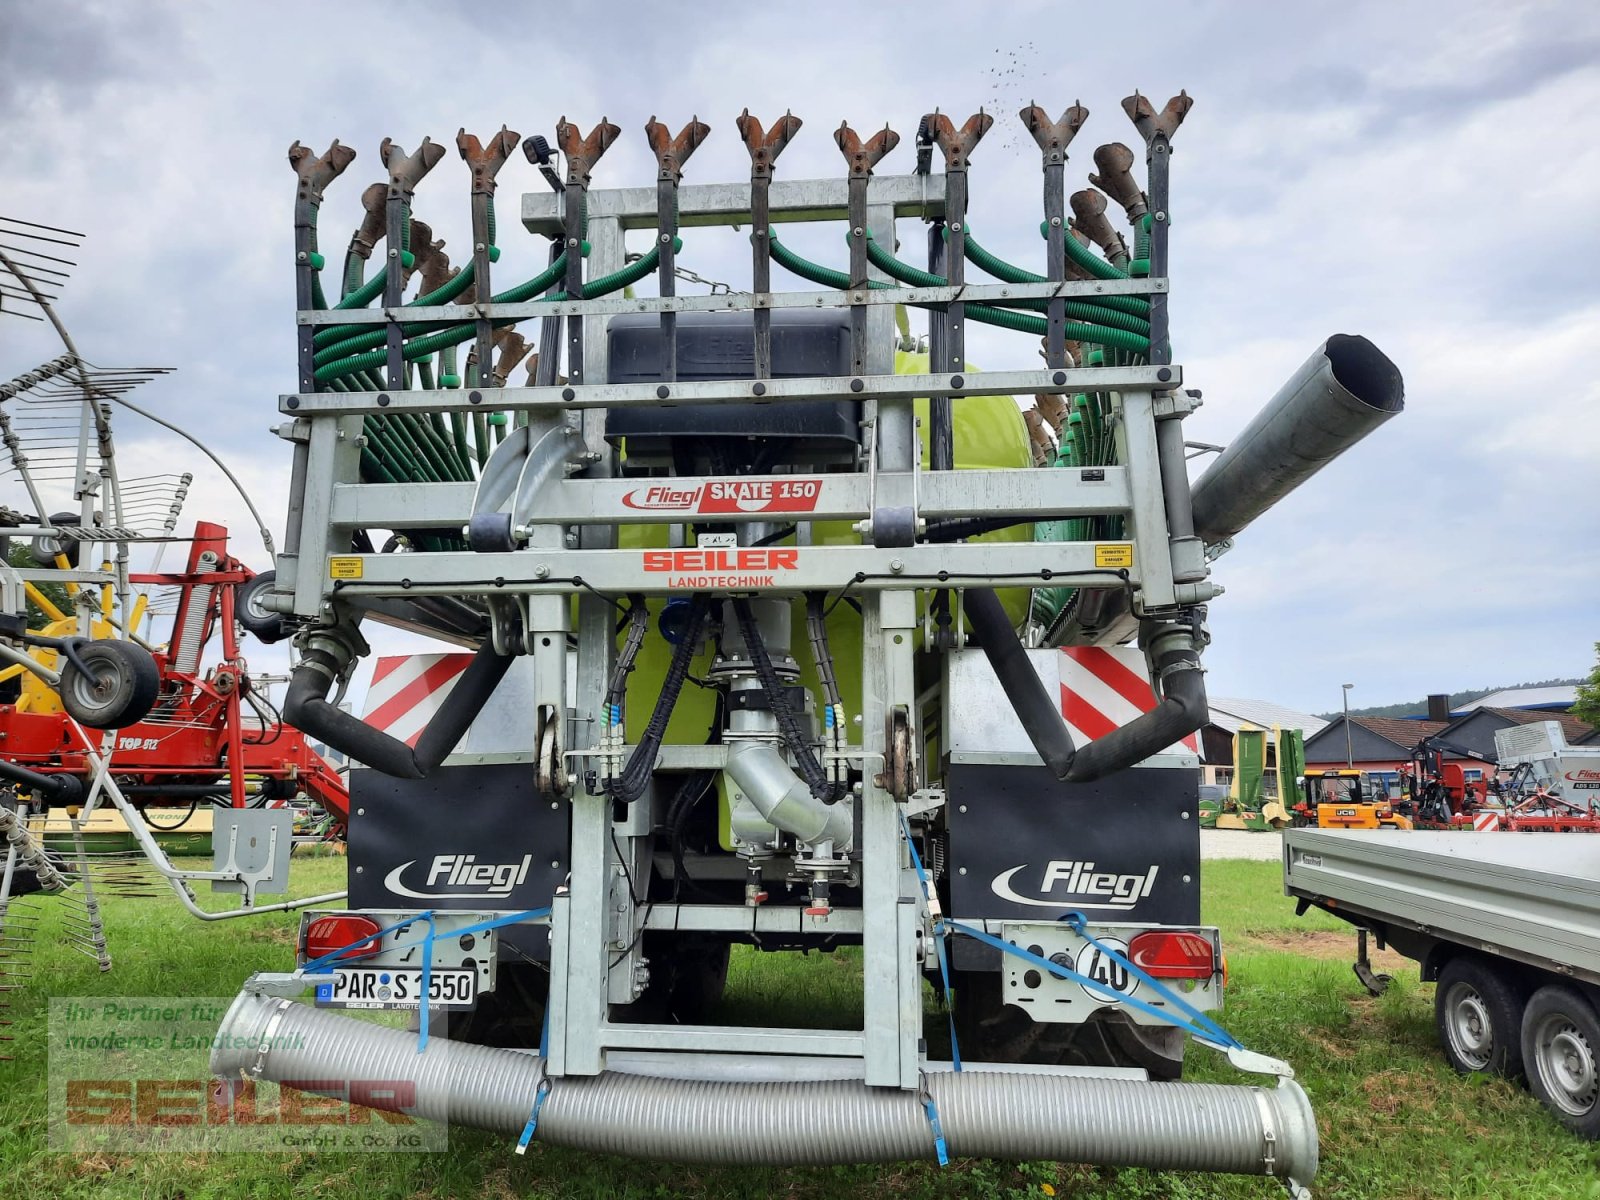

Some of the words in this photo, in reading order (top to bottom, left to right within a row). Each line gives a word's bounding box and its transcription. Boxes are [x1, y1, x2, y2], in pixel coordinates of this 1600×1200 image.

[645, 486, 702, 507] Fliegl
[711, 482, 773, 500] SKATE
[779, 482, 816, 498] 150
[643, 549, 799, 572] SEILER
[668, 575, 775, 589] LANDTECHNIK
[119, 737, 142, 750] TOP
[426, 854, 533, 892] Fliegl
[1040, 860, 1160, 904] Fliegl
[1089, 947, 1128, 991] 40
[334, 973, 377, 998] PAR
[394, 973, 408, 1000] S
[391, 1003, 440, 1011] LANDTENIK
